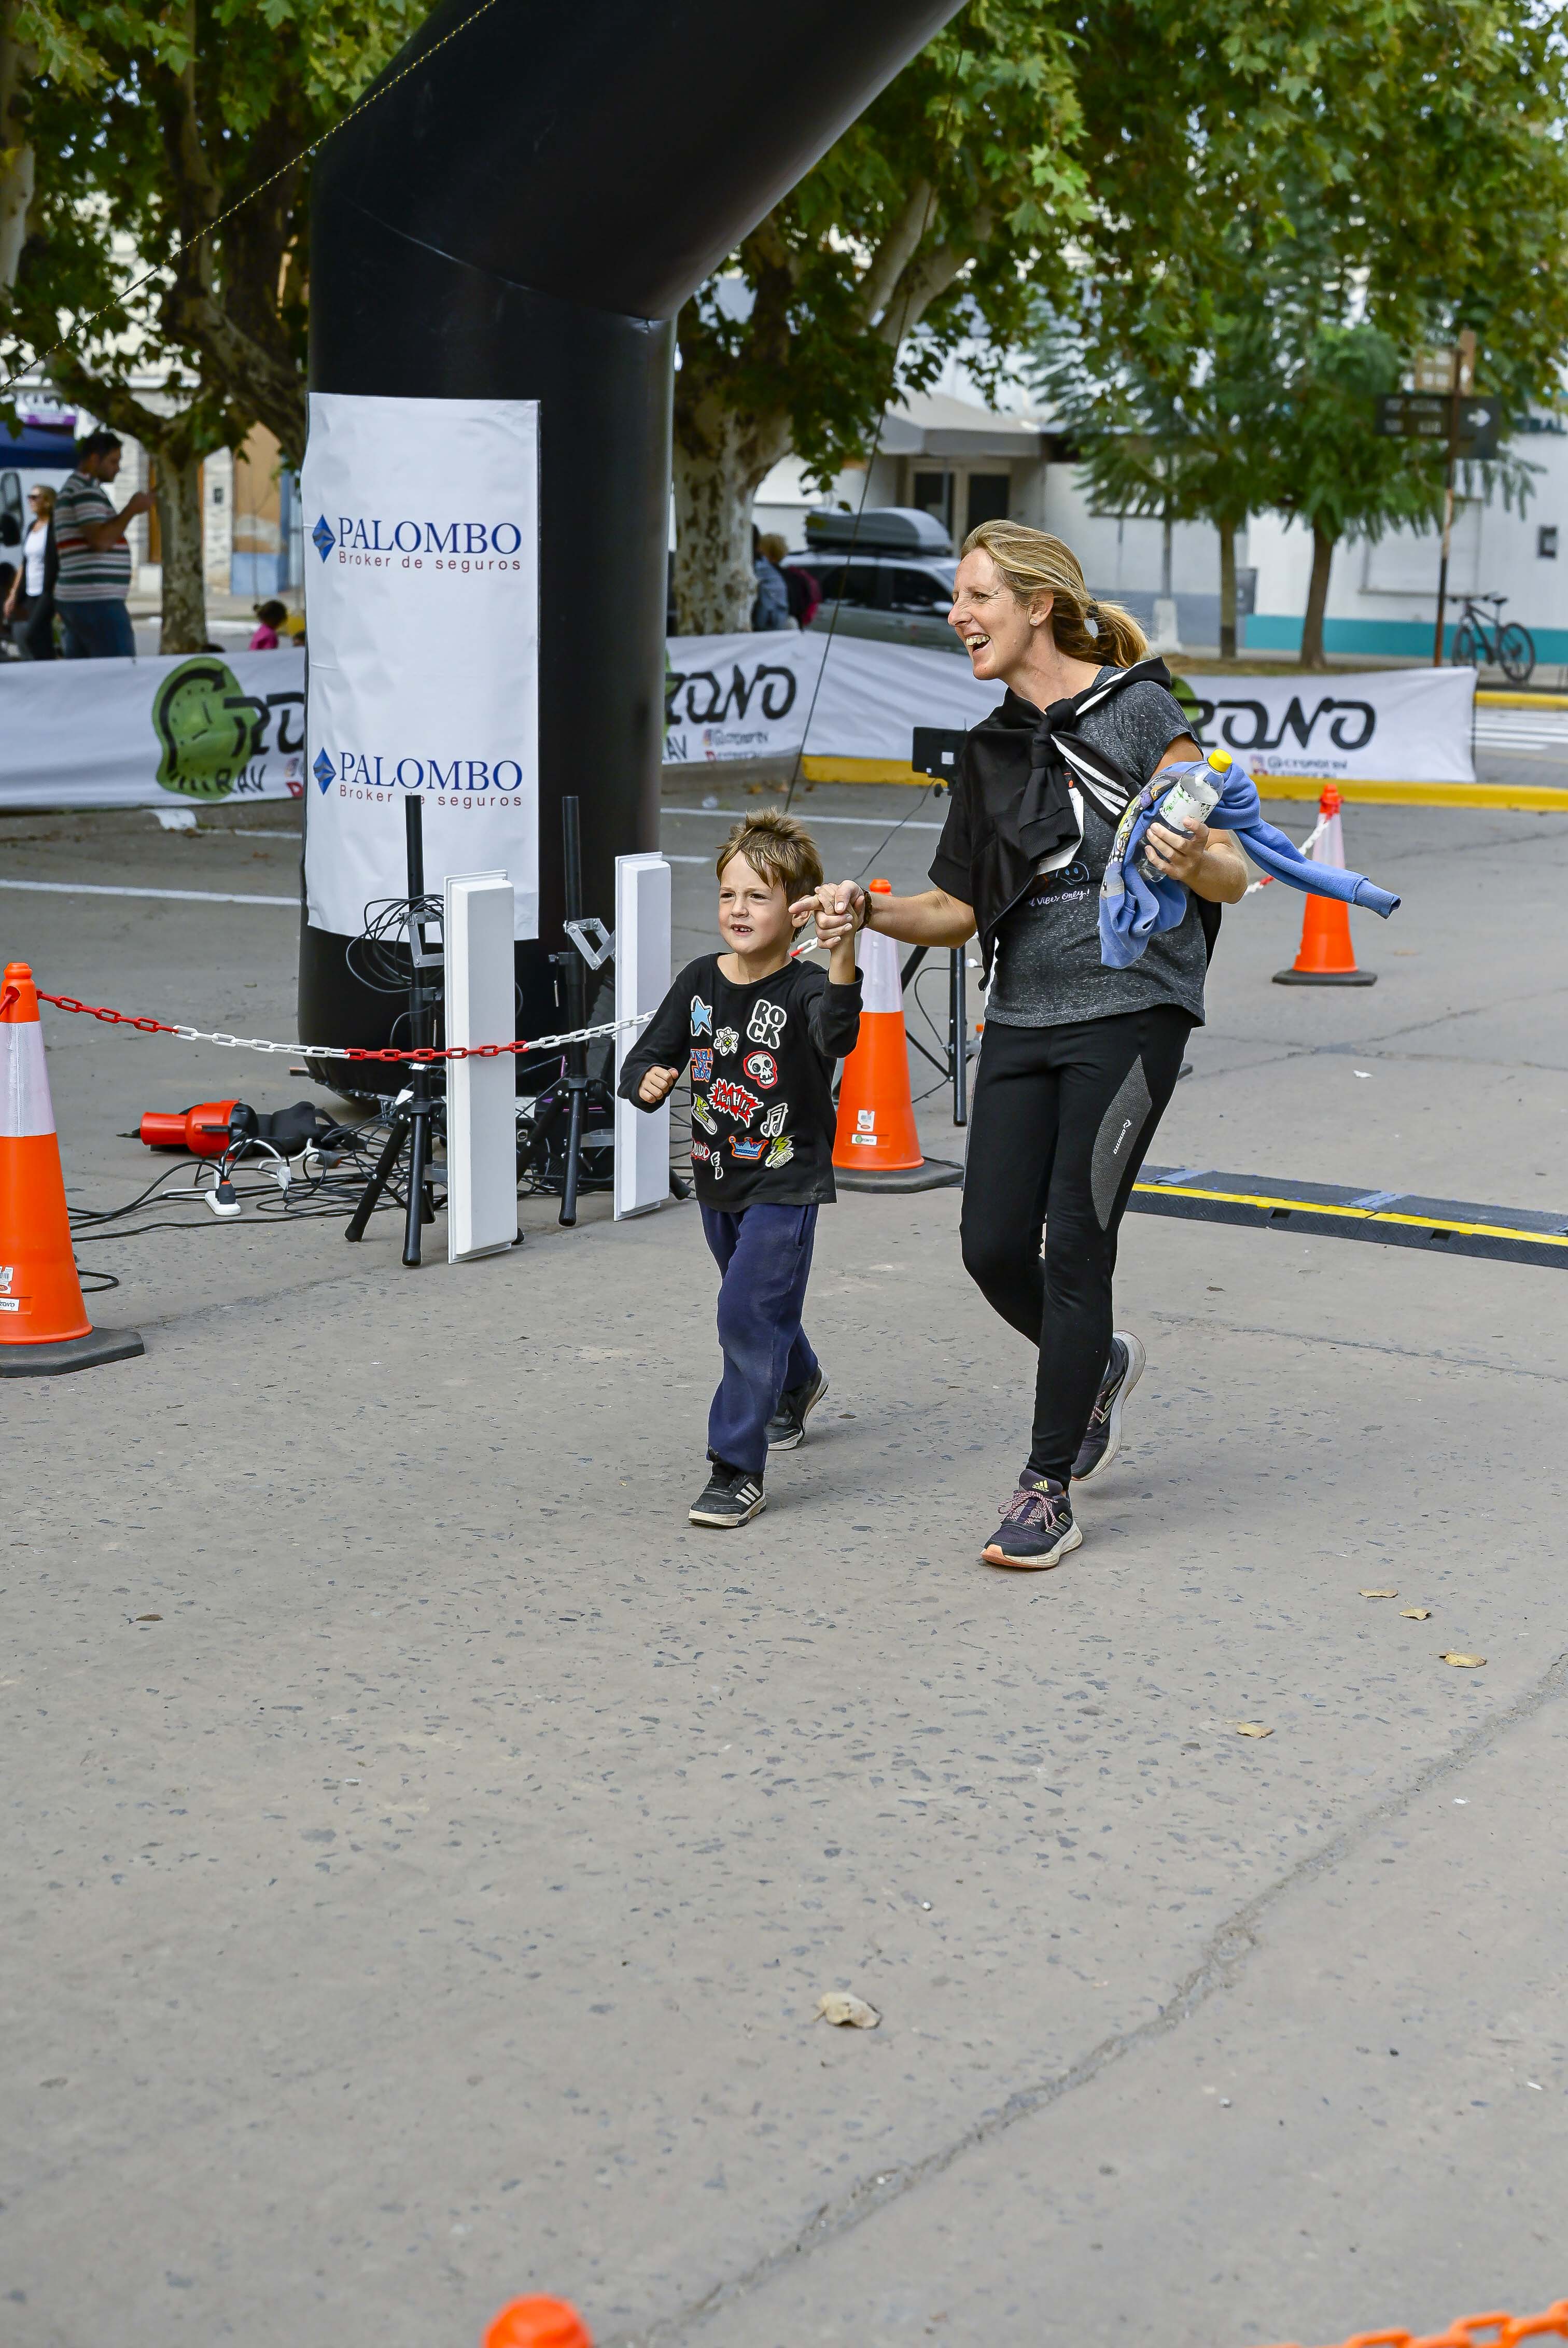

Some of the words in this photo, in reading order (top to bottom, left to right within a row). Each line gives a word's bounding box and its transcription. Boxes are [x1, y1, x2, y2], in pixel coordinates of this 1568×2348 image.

[339, 517, 522, 554] PALOMBO
[339, 551, 391, 567] Broker
[402, 556, 422, 569] de
[436, 560, 521, 573] seguros
[340, 751, 523, 791] PALOMBO
[339, 785, 393, 803] Broker
[438, 796, 522, 809] seguros
